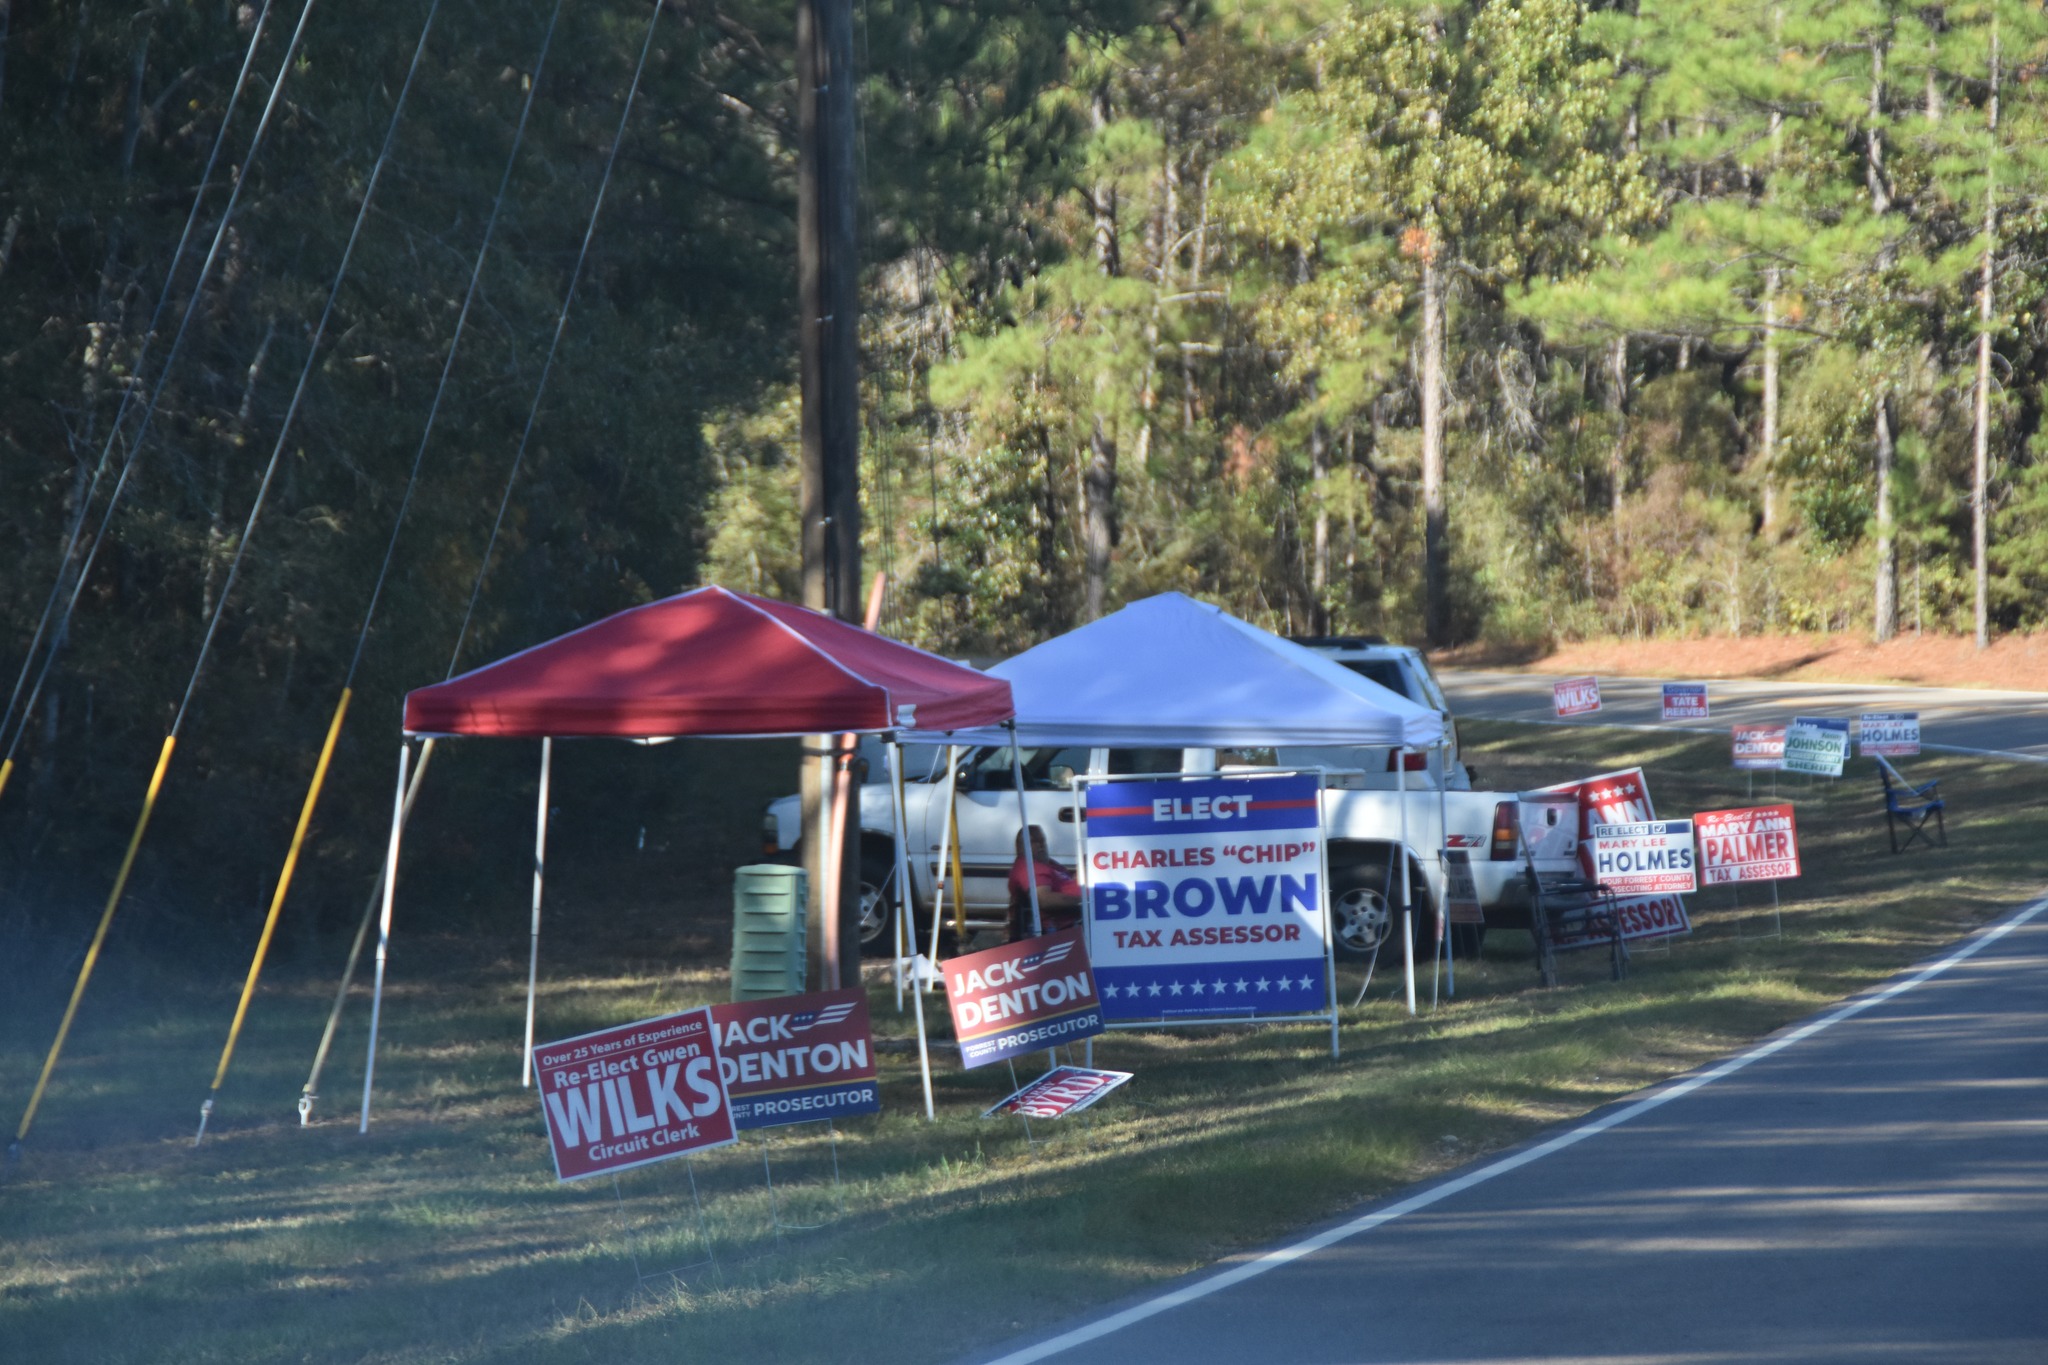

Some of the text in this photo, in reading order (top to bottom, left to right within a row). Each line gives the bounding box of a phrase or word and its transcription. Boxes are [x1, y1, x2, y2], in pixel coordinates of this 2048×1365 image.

[1557, 687, 1599, 708] WILKS
[1672, 696, 1698, 706] TATE
[1666, 707, 1706, 717] REEVES
[1736, 730, 1765, 741] JACK
[1786, 736, 1842, 753] JOHNSON
[1862, 728, 1918, 742] HOLMES
[1786, 760, 1836, 772] SHERIFF
[1153, 795, 1253, 822] ELECT
[1601, 824, 1647, 836] RE ELECT
[1701, 816, 1791, 838] MARY ANN
[1446, 834, 1488, 848] Z71
[1599, 837, 1667, 850] MARY LEE
[1706, 832, 1790, 865] PALMER
[1093, 846, 1215, 870] CHARLES
[1599, 848, 1692, 874] HOLMES
[1624, 875, 1657, 884] FORREST
[1660, 874, 1691, 882] COUNTY
[1710, 861, 1792, 882] TAX ASSESSOR
[1094, 873, 1319, 921] BROWN
[1654, 882, 1692, 892] ATTORNEY
[1113, 923, 1301, 949] TAX ASSESSOR
[953, 958, 1025, 998] JACK
[957, 972, 1092, 1029] DENTON
[714, 1013, 795, 1047] JACK
[998, 1014, 1098, 1051] PROSECUTOR
[543, 1021, 703, 1066] Over 25 Years of Experience
[968, 1045, 997, 1058] COUNTY
[554, 1041, 701, 1089] Re-Elect Gwen
[721, 1039, 869, 1086] DENTON
[546, 1056, 722, 1149] WILKS
[754, 1089, 874, 1116] PROSECUTOR
[1011, 1074, 1105, 1118] BYRD
[588, 1122, 701, 1162] Circuit Clerk
